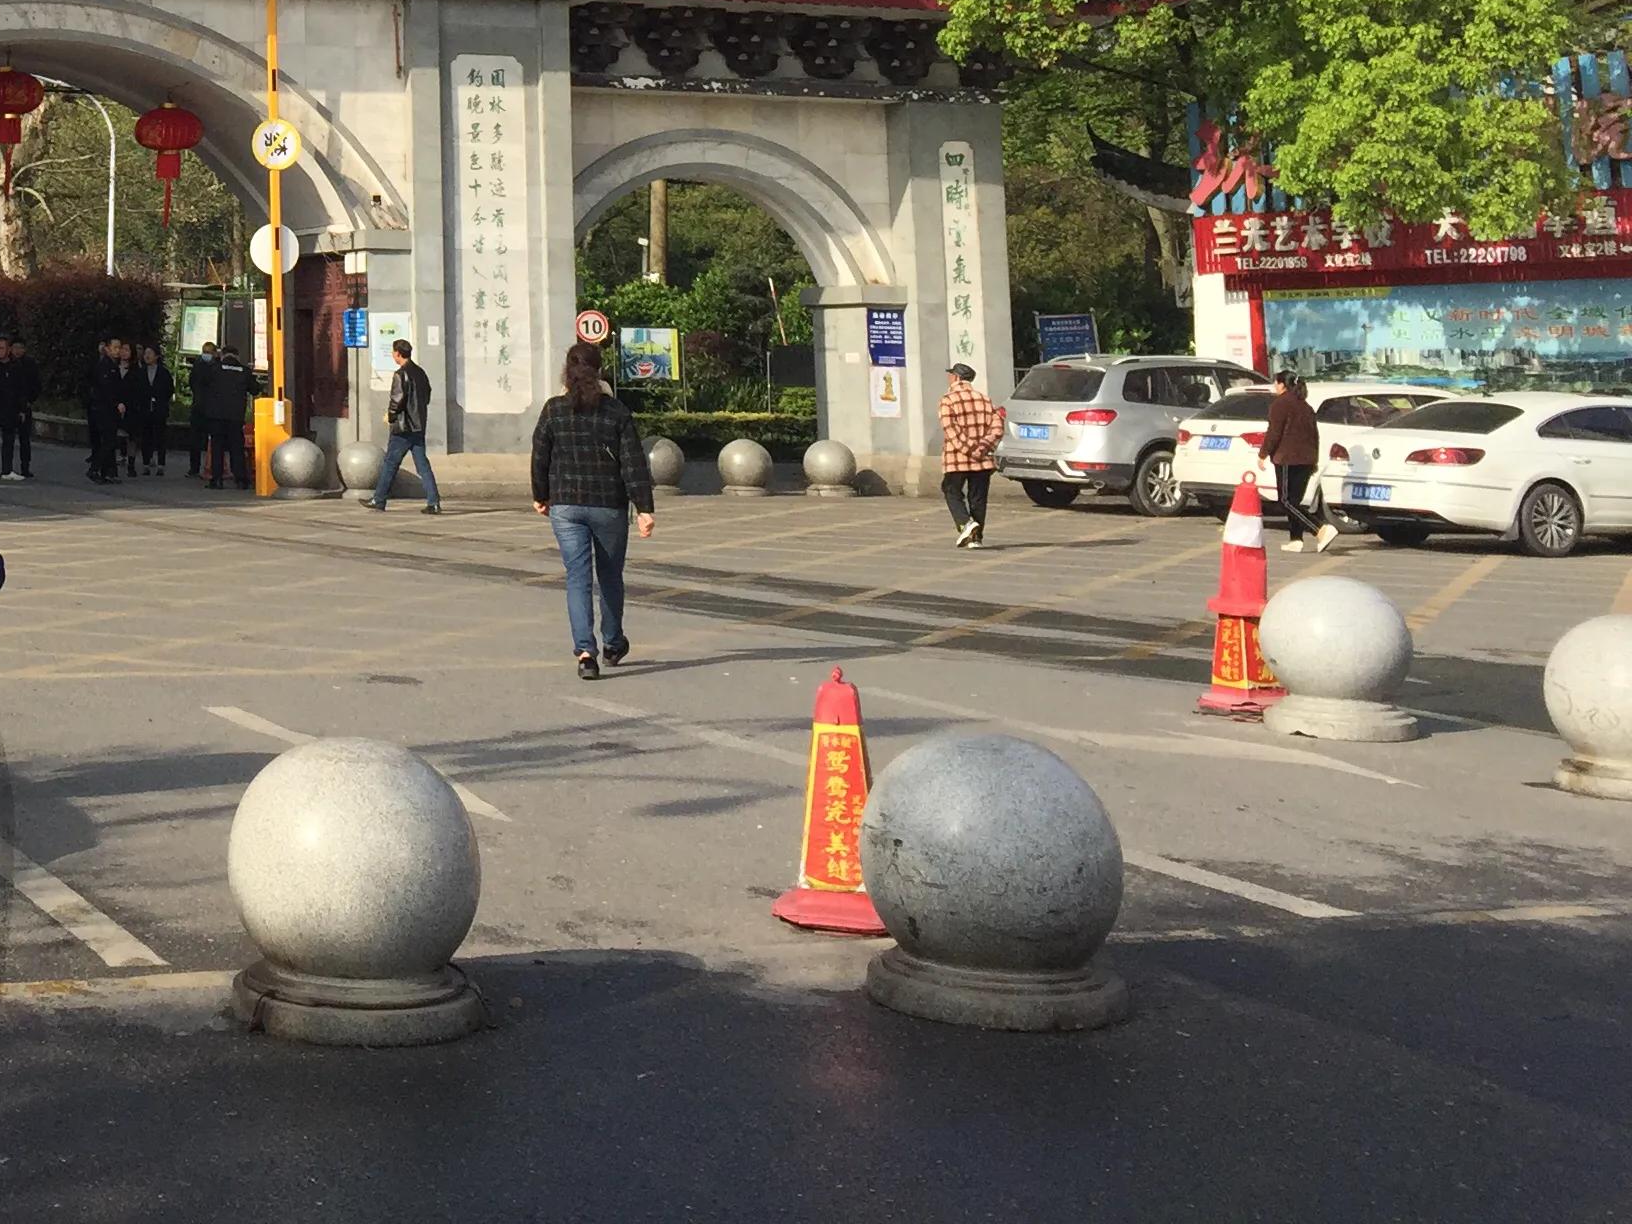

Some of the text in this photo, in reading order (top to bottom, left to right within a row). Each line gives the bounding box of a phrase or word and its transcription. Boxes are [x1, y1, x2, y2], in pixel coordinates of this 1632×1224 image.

[1424, 245, 1528, 265] TEL:22201798
[581, 319, 603, 336] 10
[824, 750, 852, 882] 鸳鸯瓷美缝
